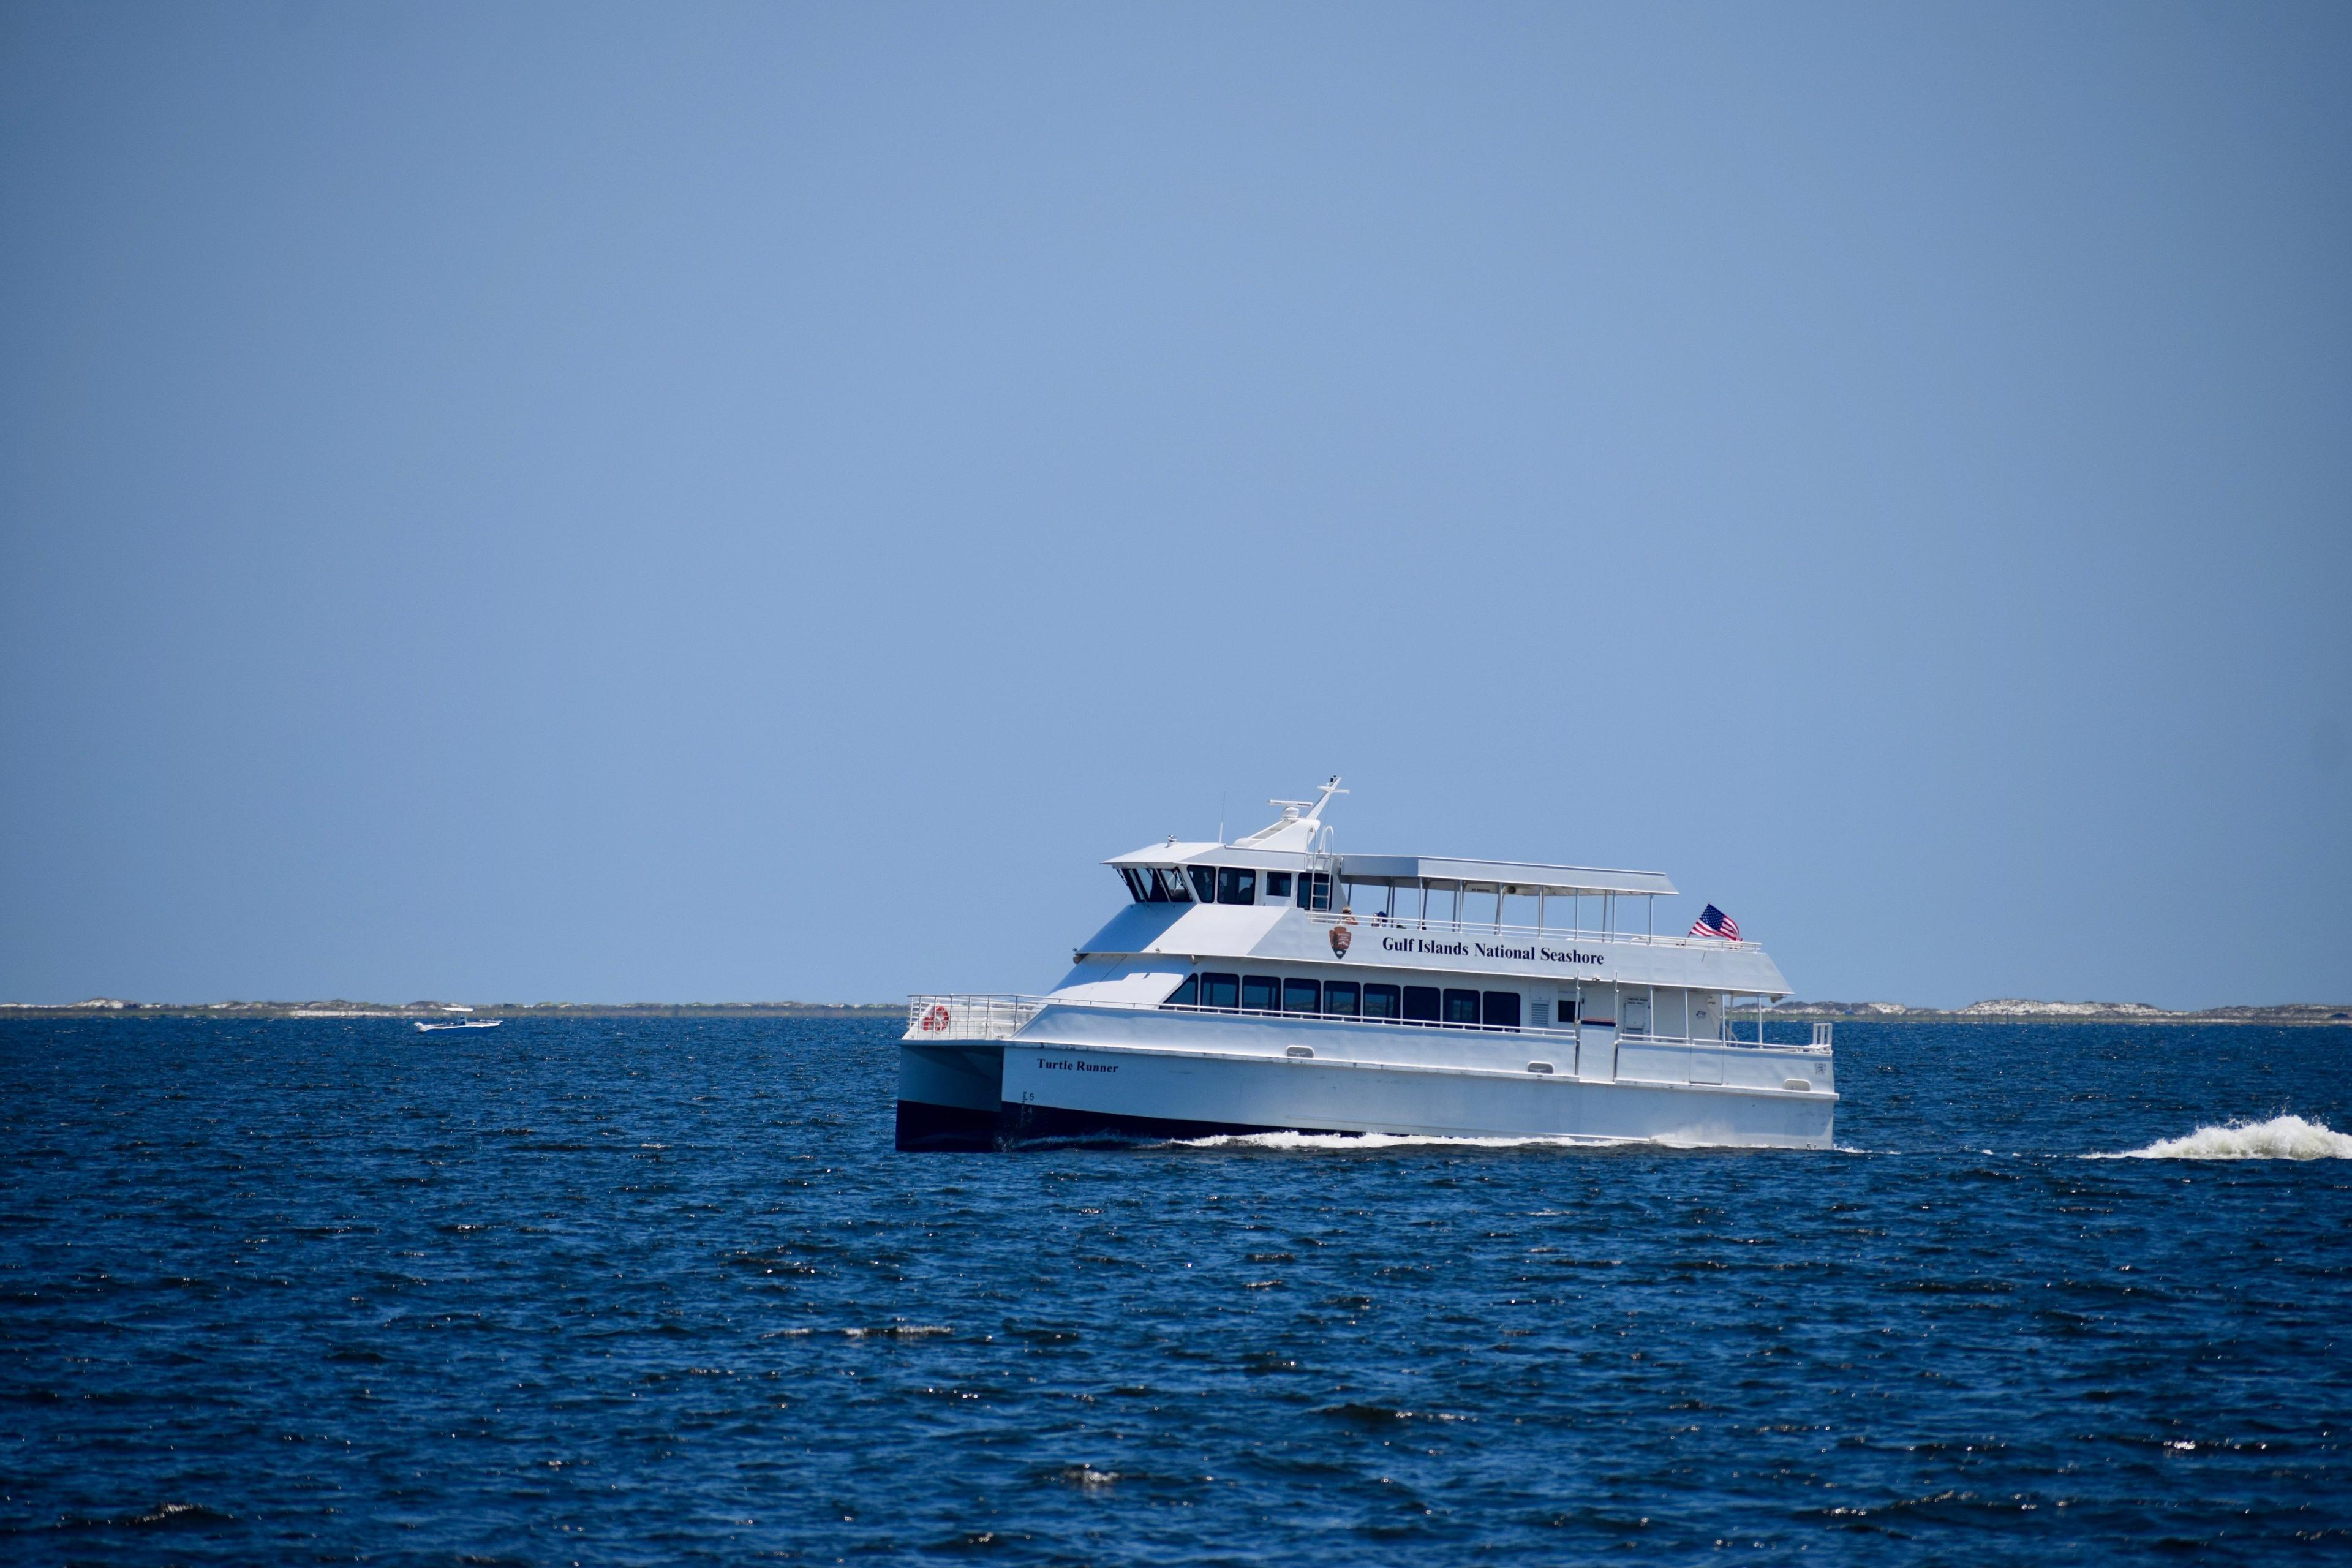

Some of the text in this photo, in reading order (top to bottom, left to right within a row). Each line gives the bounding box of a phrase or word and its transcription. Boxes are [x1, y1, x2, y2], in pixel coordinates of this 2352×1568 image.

[1382, 937, 1604, 965] Gulf Islands National Seashore
[1038, 1058, 1118, 1072] Turtle Runner
